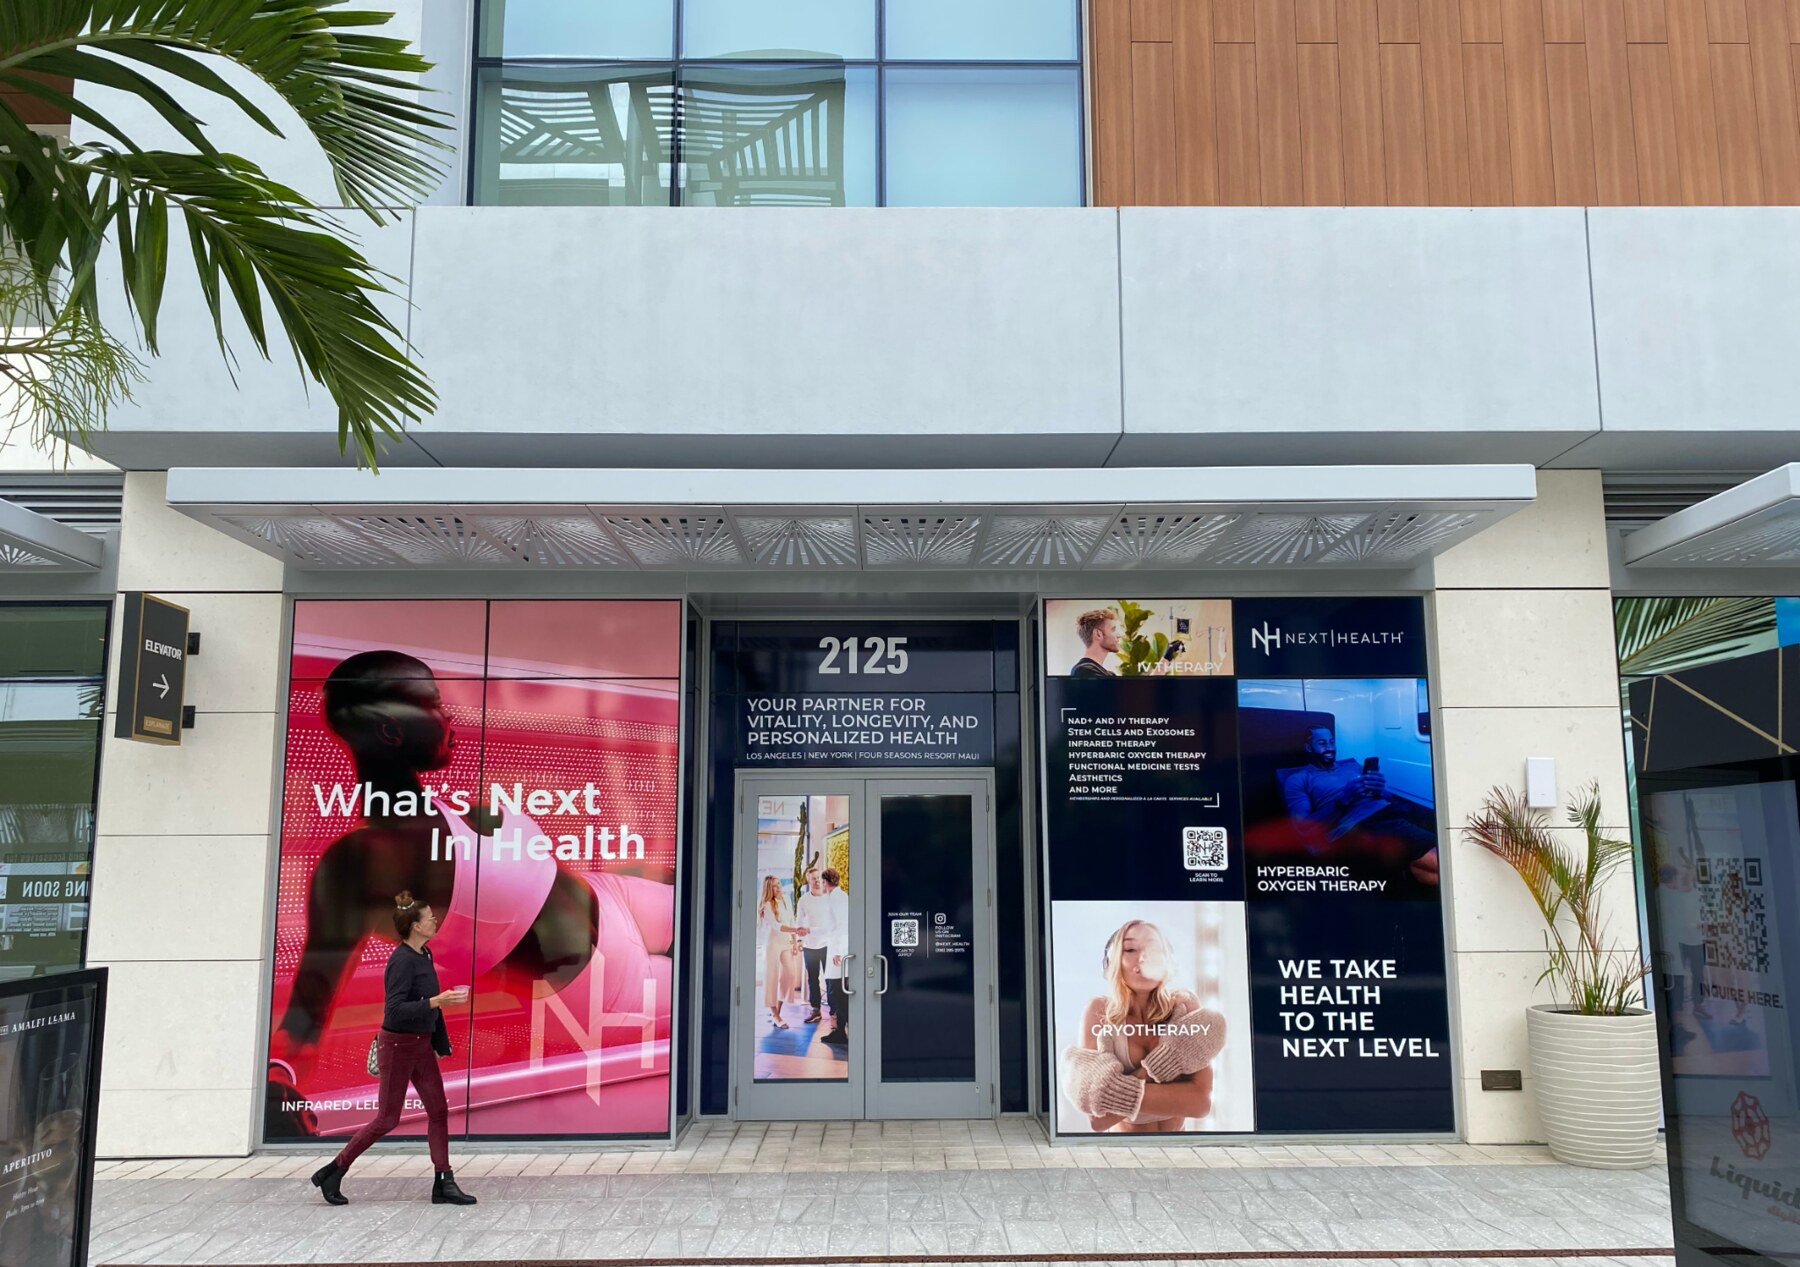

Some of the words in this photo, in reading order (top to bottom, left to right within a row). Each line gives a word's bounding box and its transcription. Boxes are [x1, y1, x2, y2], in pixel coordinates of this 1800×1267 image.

[145, 639, 182, 660] ELEVATOR
[818, 636, 909, 674] 2125
[1138, 661, 1152, 672] IV
[1155, 661, 1224, 672] THERAPY
[747, 698, 797, 712] YOUR
[802, 698, 884, 711] PARTNER
[890, 698, 926, 711] FOR
[747, 715, 827, 730] VITALITY,
[832, 715, 934, 730] LONGEVITY,
[939, 715, 978, 728] AND
[748, 731, 884, 745] PERSONALIZED
[890, 731, 958, 744] HEALTH
[746, 752, 762, 760] LOS
[764, 752, 802, 760] ANGELES
[808, 752, 828, 760] NEW
[830, 752, 853, 760] YORK
[859, 752, 882, 760] FOUR
[884, 752, 922, 760] SEASONS
[924, 752, 956, 760] RESORT
[958, 752, 980, 760] MAUI
[1069, 774, 1122, 782] AESTHETICS
[490, 782, 602, 816] Next
[430, 828, 471, 861] In
[492, 825, 646, 861] Health
[1257, 866, 1350, 878] HYPERBARIC
[1257, 880, 1318, 892] OXYGEN
[1322, 880, 1387, 892] THERAPY
[1278, 959, 1322, 979] WE
[1330, 959, 1397, 979] TAKE
[1280, 985, 1381, 1006] HEALTH
[1700, 983, 1745, 1003] INQUIRE
[1747, 990, 1784, 1009] HERE.
[12, 1017, 46, 1033] AMALFI
[1091, 1023, 1212, 1037] CRYOTHERAPY
[1279, 1011, 1315, 1032] TO
[1322, 1011, 1375, 1031] THE
[1282, 1038, 1349, 1058] NEXT
[1359, 1038, 1440, 1058] LEVEL
[281, 1100, 353, 1112] INFRARED
[356, 1100, 380, 1111] LED
[2, 1148, 52, 1175] APERITIVO
[1710, 1155, 1800, 1210] Liquid
